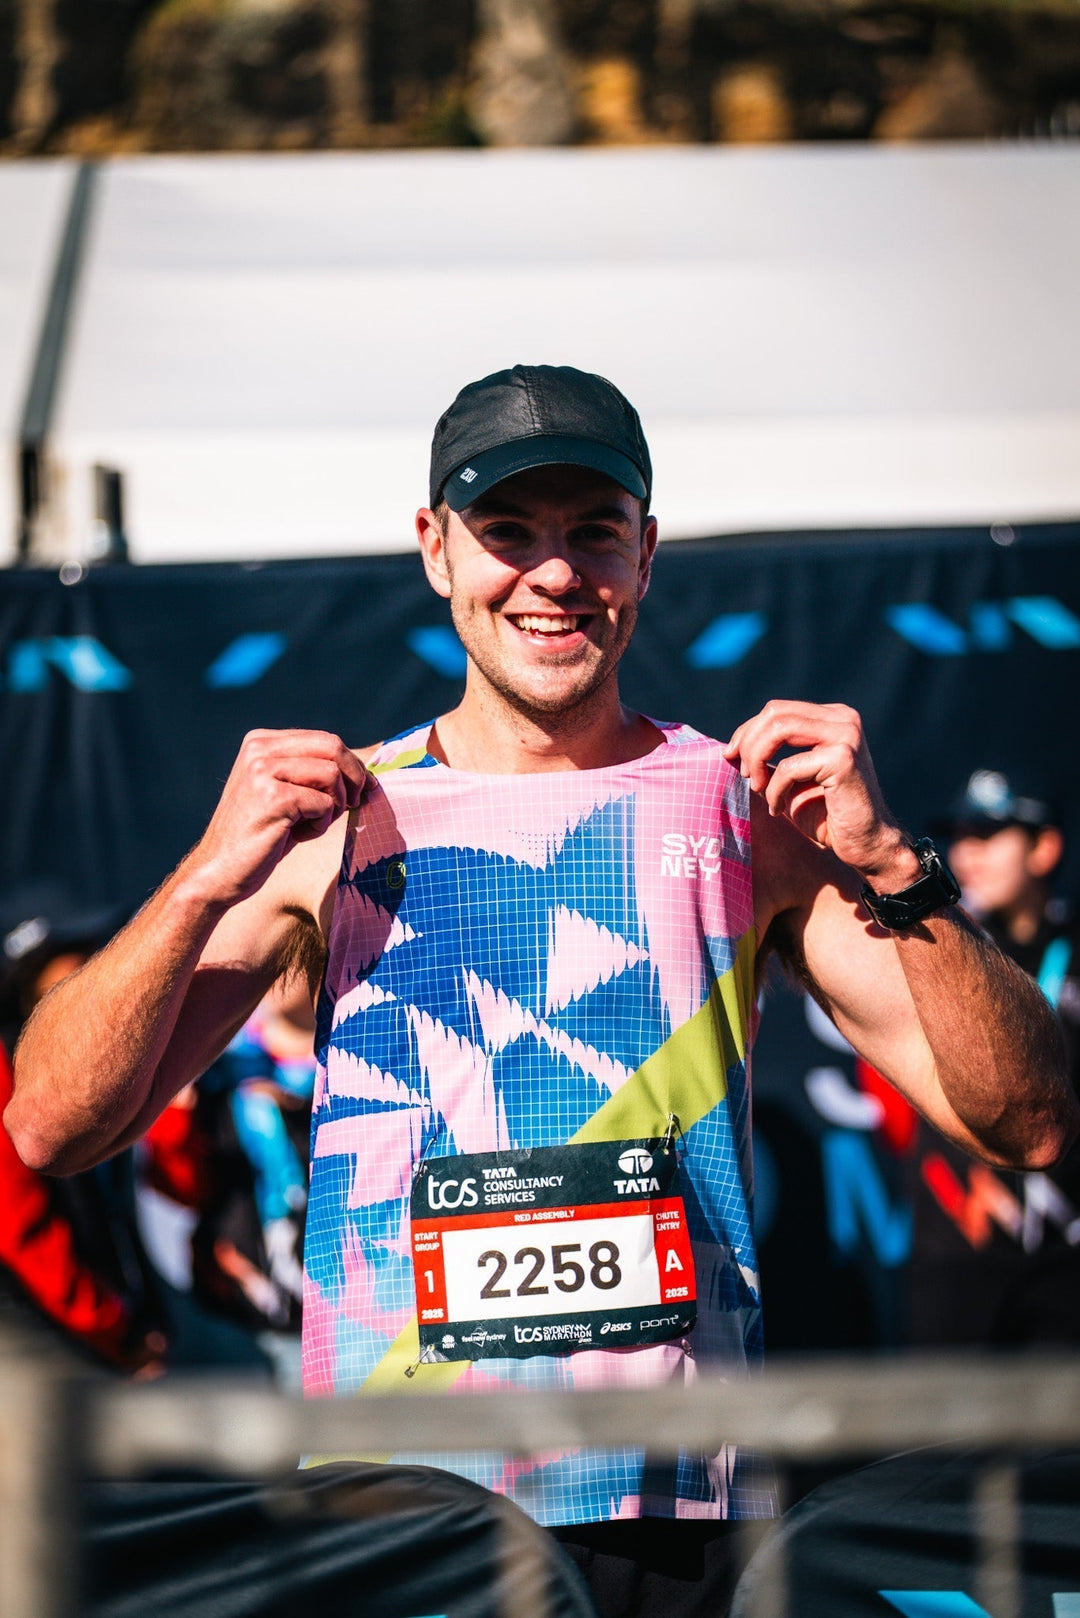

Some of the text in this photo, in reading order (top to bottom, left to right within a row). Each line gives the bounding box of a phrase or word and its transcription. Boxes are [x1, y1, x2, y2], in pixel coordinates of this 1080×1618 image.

[460, 467, 478, 483] 2XU
[661, 833, 721, 858] SYD
[660, 855, 722, 881] NEY
[482, 1167, 517, 1179] TATA
[428, 1174, 479, 1210] tcs
[483, 1176, 564, 1193] CONSULTANCY
[613, 1177, 661, 1195] TATA
[484, 1191, 536, 1205] SERVICES
[514, 1209, 575, 1222] RED ASSEMBLY
[655, 1211, 680, 1221] CHUTE
[656, 1221, 681, 1232] ENTRY
[414, 1231, 438, 1241] START
[415, 1242, 440, 1252] GROUP
[665, 1249, 683, 1273] A
[477, 1240, 622, 1300] 2258
[424, 1270, 434, 1293] 1
[665, 1286, 689, 1299] 2025
[514, 1324, 543, 1344] tcs
[543, 1324, 574, 1335] SYDNEY
[543, 1331, 592, 1341] MARATHON
